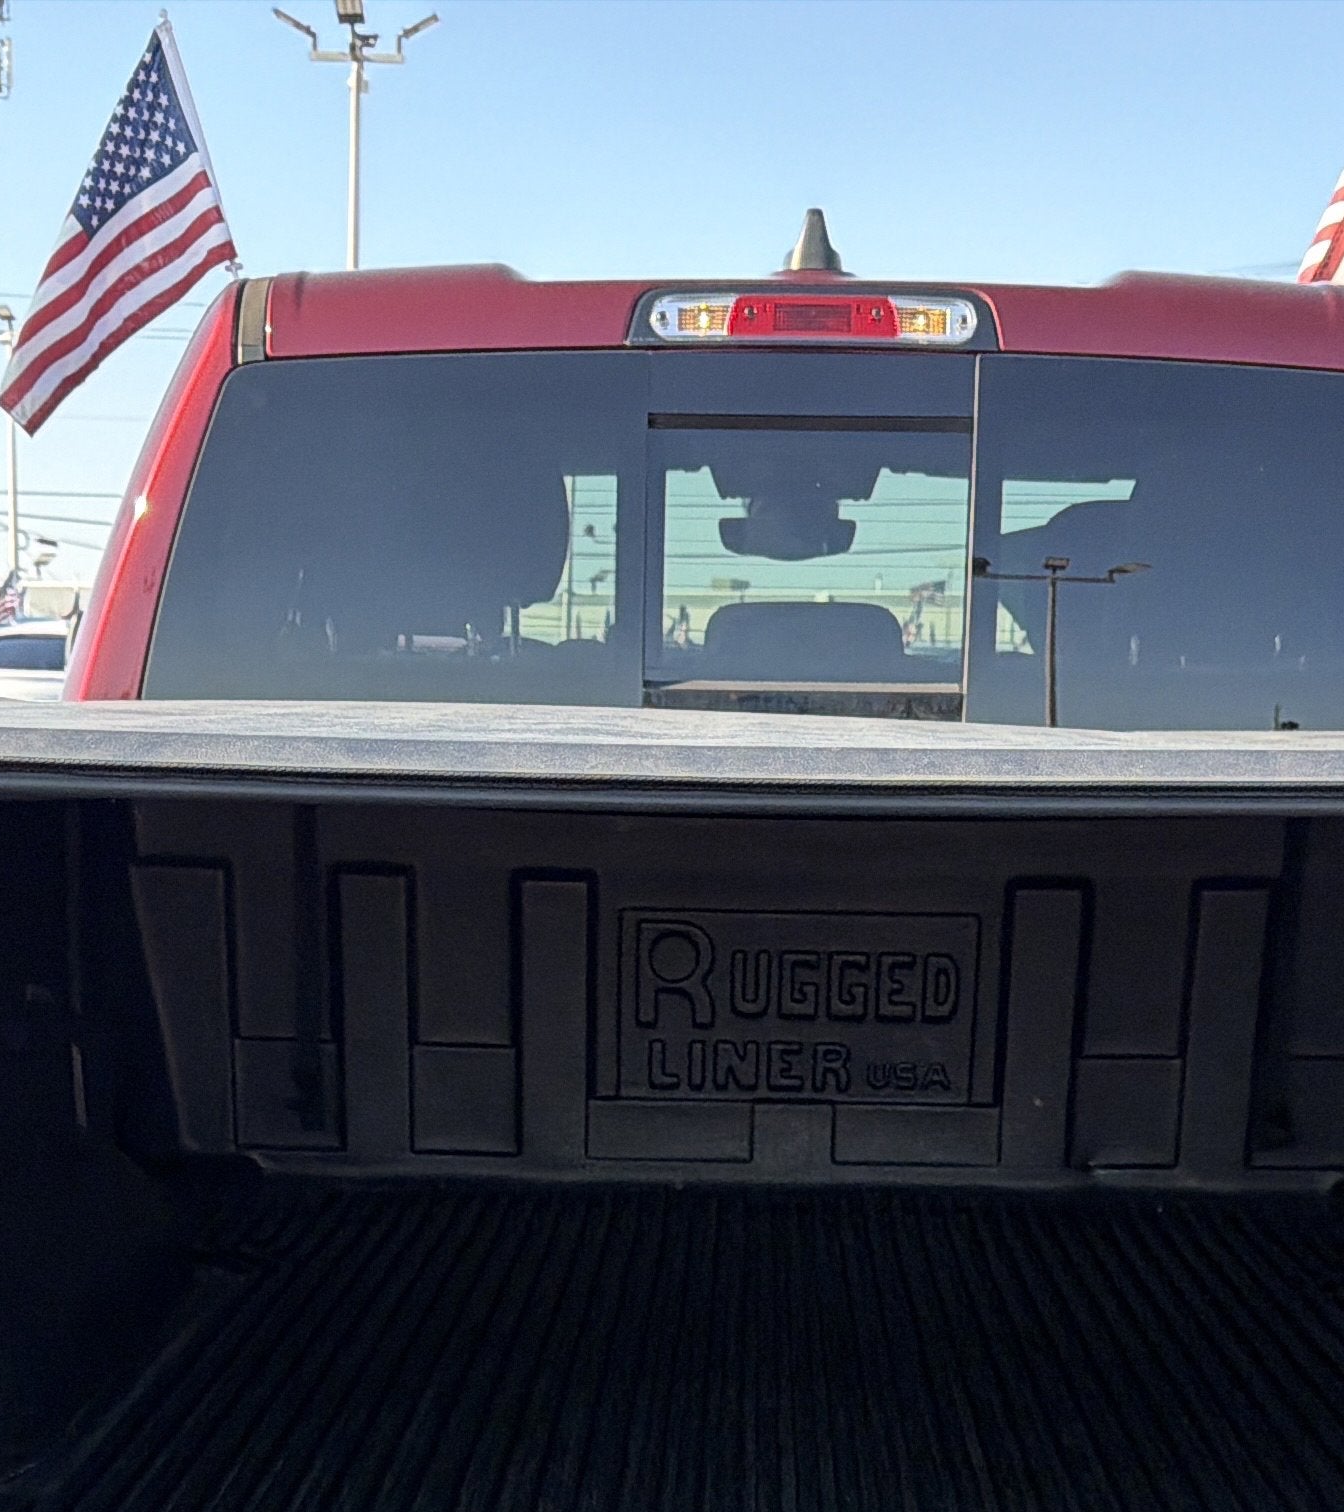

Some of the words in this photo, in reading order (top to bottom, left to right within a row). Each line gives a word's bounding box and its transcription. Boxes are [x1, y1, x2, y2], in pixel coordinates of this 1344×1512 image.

[635, 920, 960, 1030] RUGGED
[648, 1038, 851, 1093] LINER
[866, 1061, 952, 1090] USA
